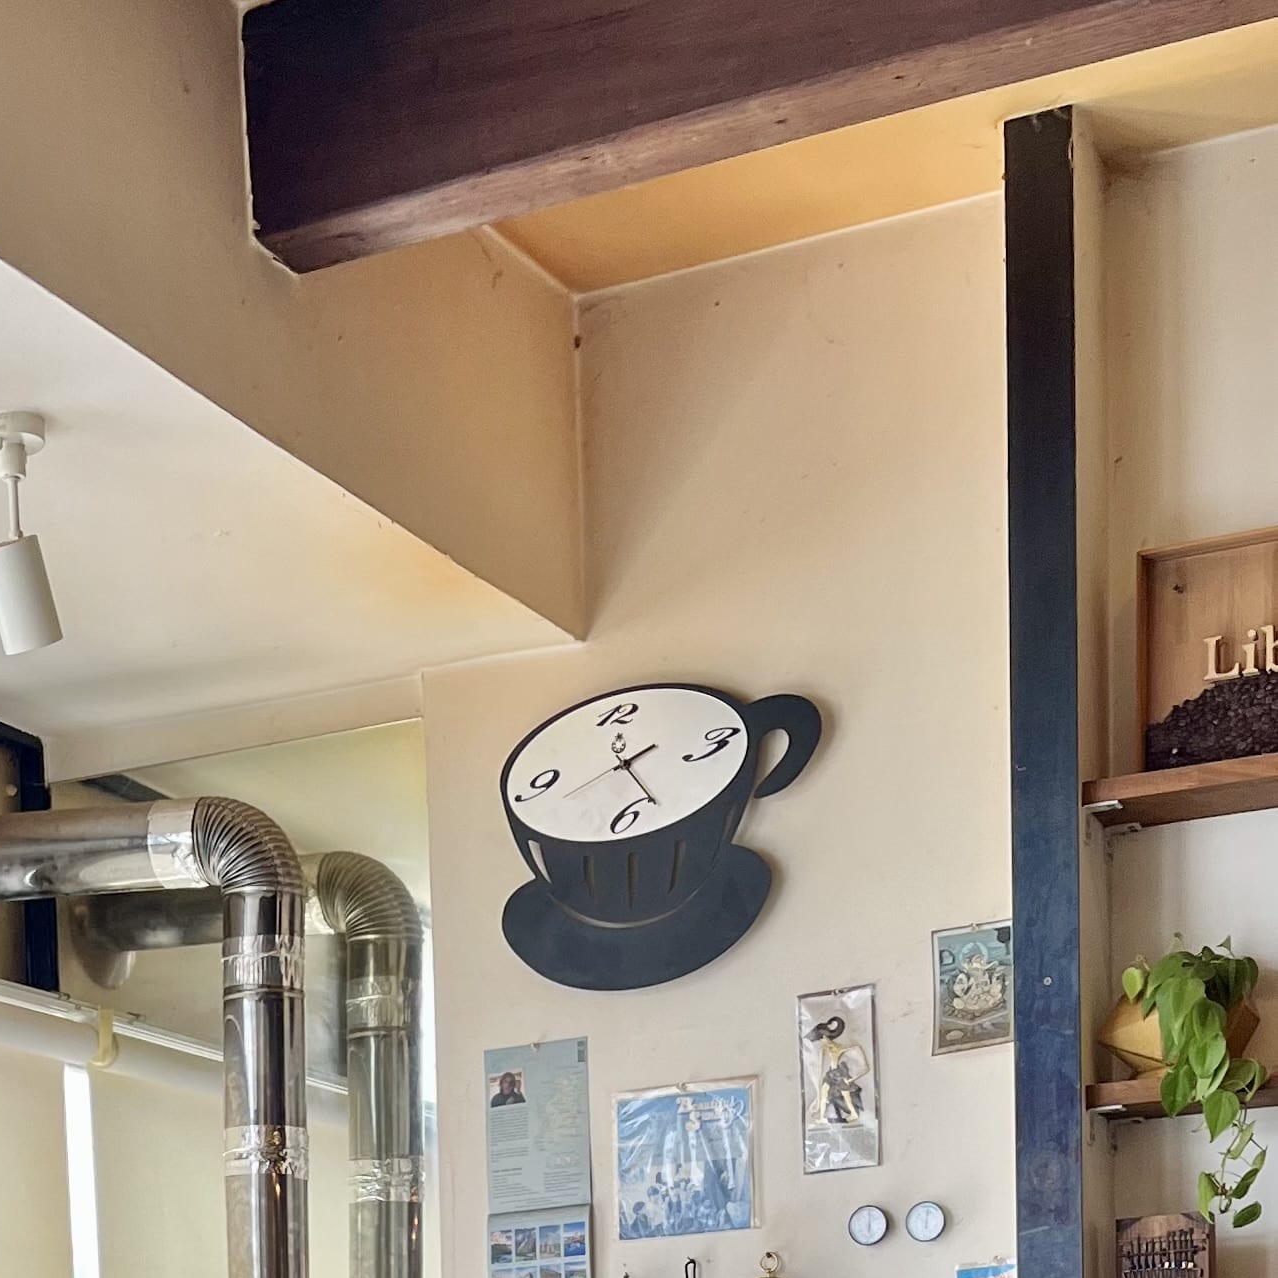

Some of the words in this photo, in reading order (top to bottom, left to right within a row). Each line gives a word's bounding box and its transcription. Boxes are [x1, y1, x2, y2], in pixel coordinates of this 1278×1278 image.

[596, 703, 639, 727] 12
[682, 727, 741, 762] 3
[514, 769, 561, 802] 9
[610, 797, 653, 834] 6
